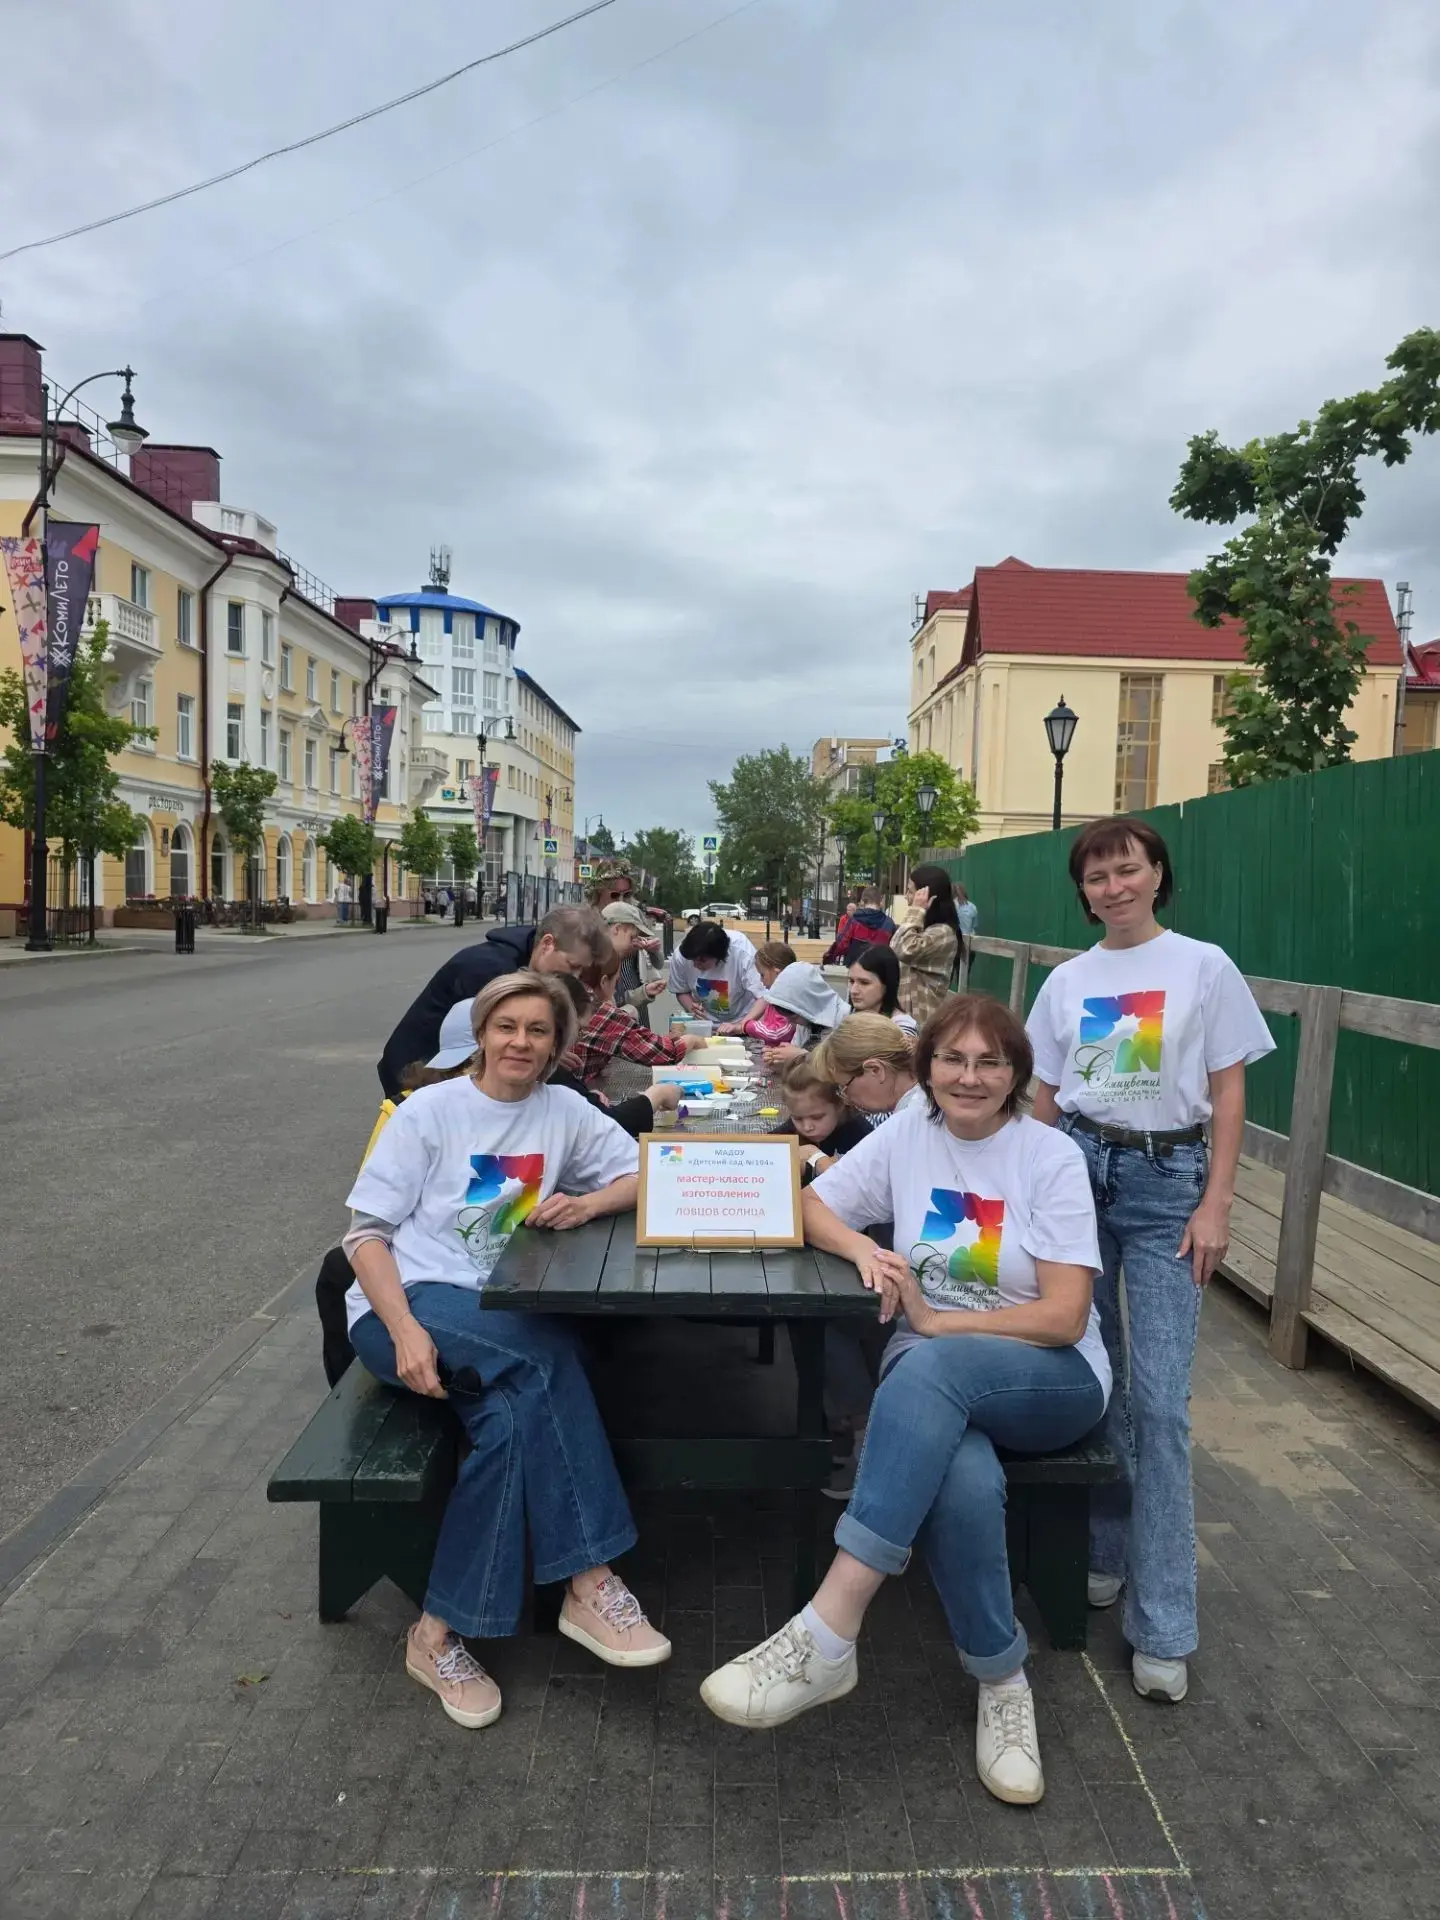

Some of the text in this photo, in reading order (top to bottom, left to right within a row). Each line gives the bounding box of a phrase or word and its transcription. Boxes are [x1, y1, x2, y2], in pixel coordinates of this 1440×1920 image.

[714, 1149, 745, 1157] МАДОУ
[676, 1175, 765, 1185] мастер-класс по
[682, 1190, 760, 1199] изготовлению
[675, 1207, 766, 1218] ЛОВЦОВ СОЛНЦА
